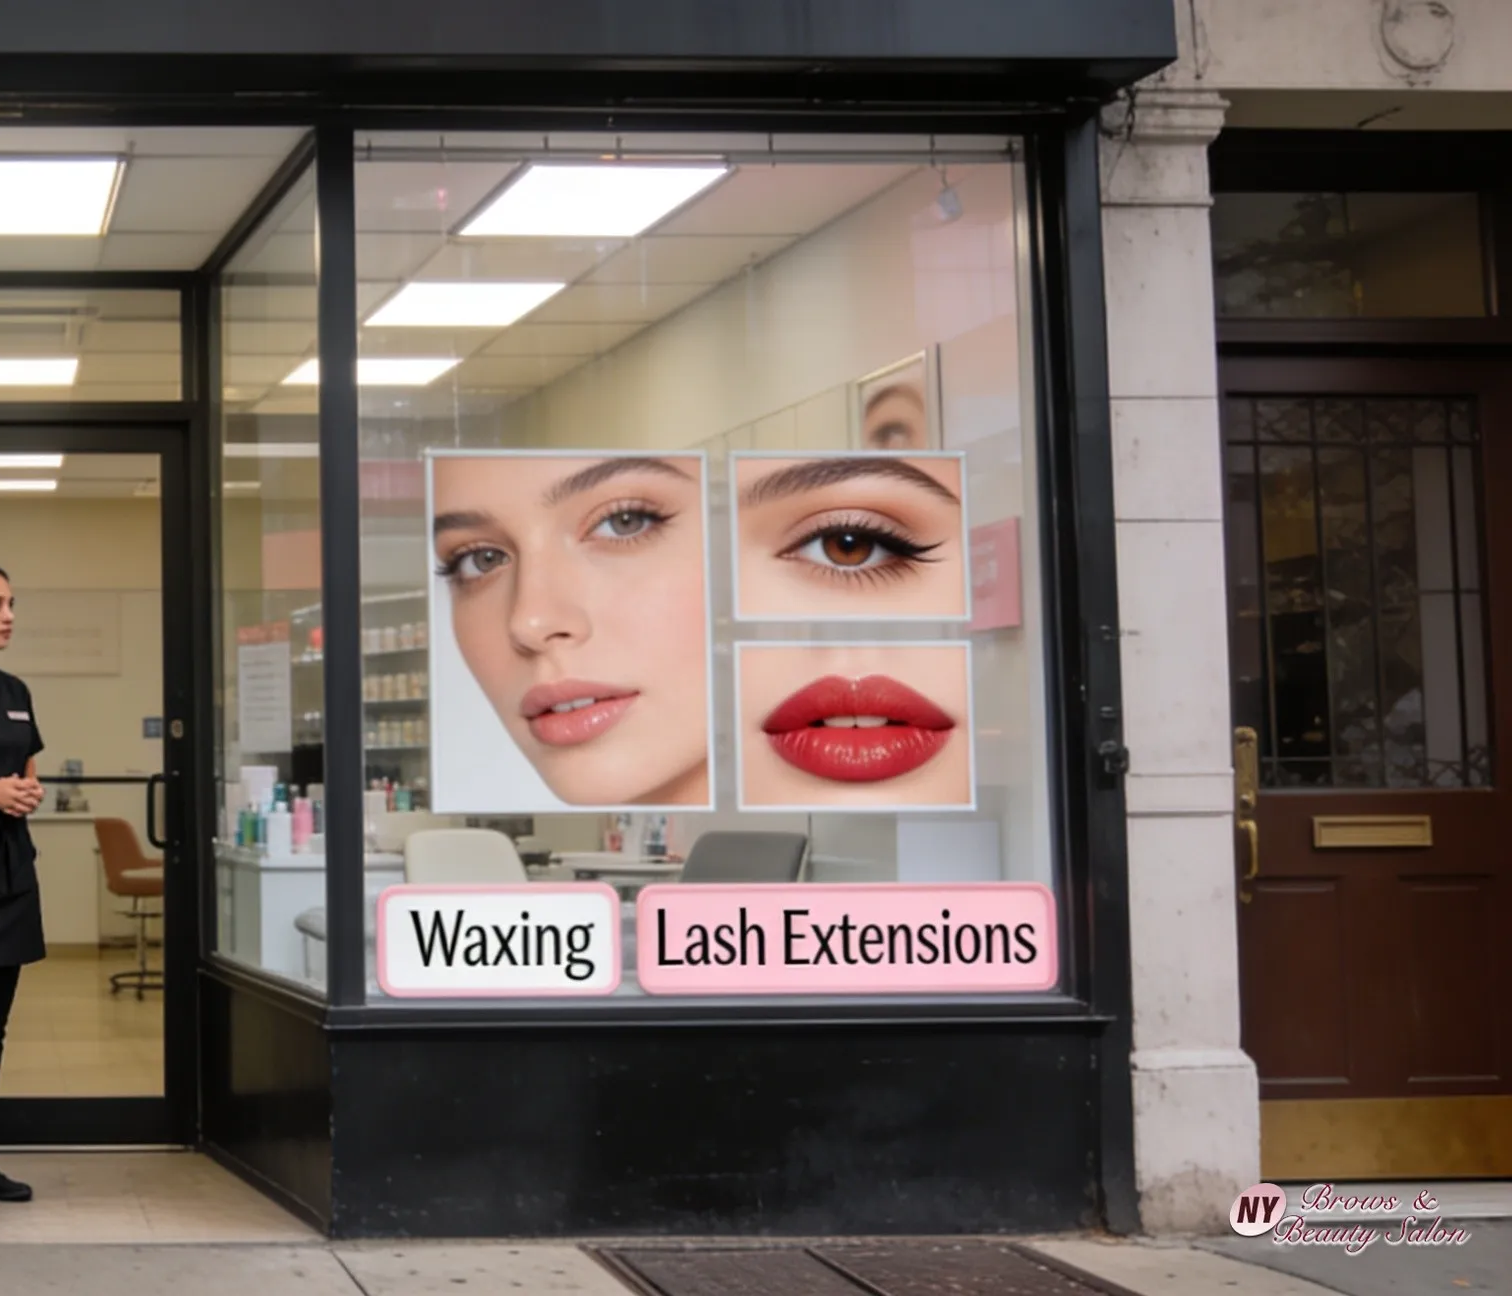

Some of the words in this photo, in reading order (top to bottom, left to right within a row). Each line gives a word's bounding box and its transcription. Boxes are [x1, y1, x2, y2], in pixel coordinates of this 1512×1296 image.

[410, 910, 596, 981] Waxing
[656, 907, 766, 966] Lash
[783, 909, 1038, 966] Extensions
